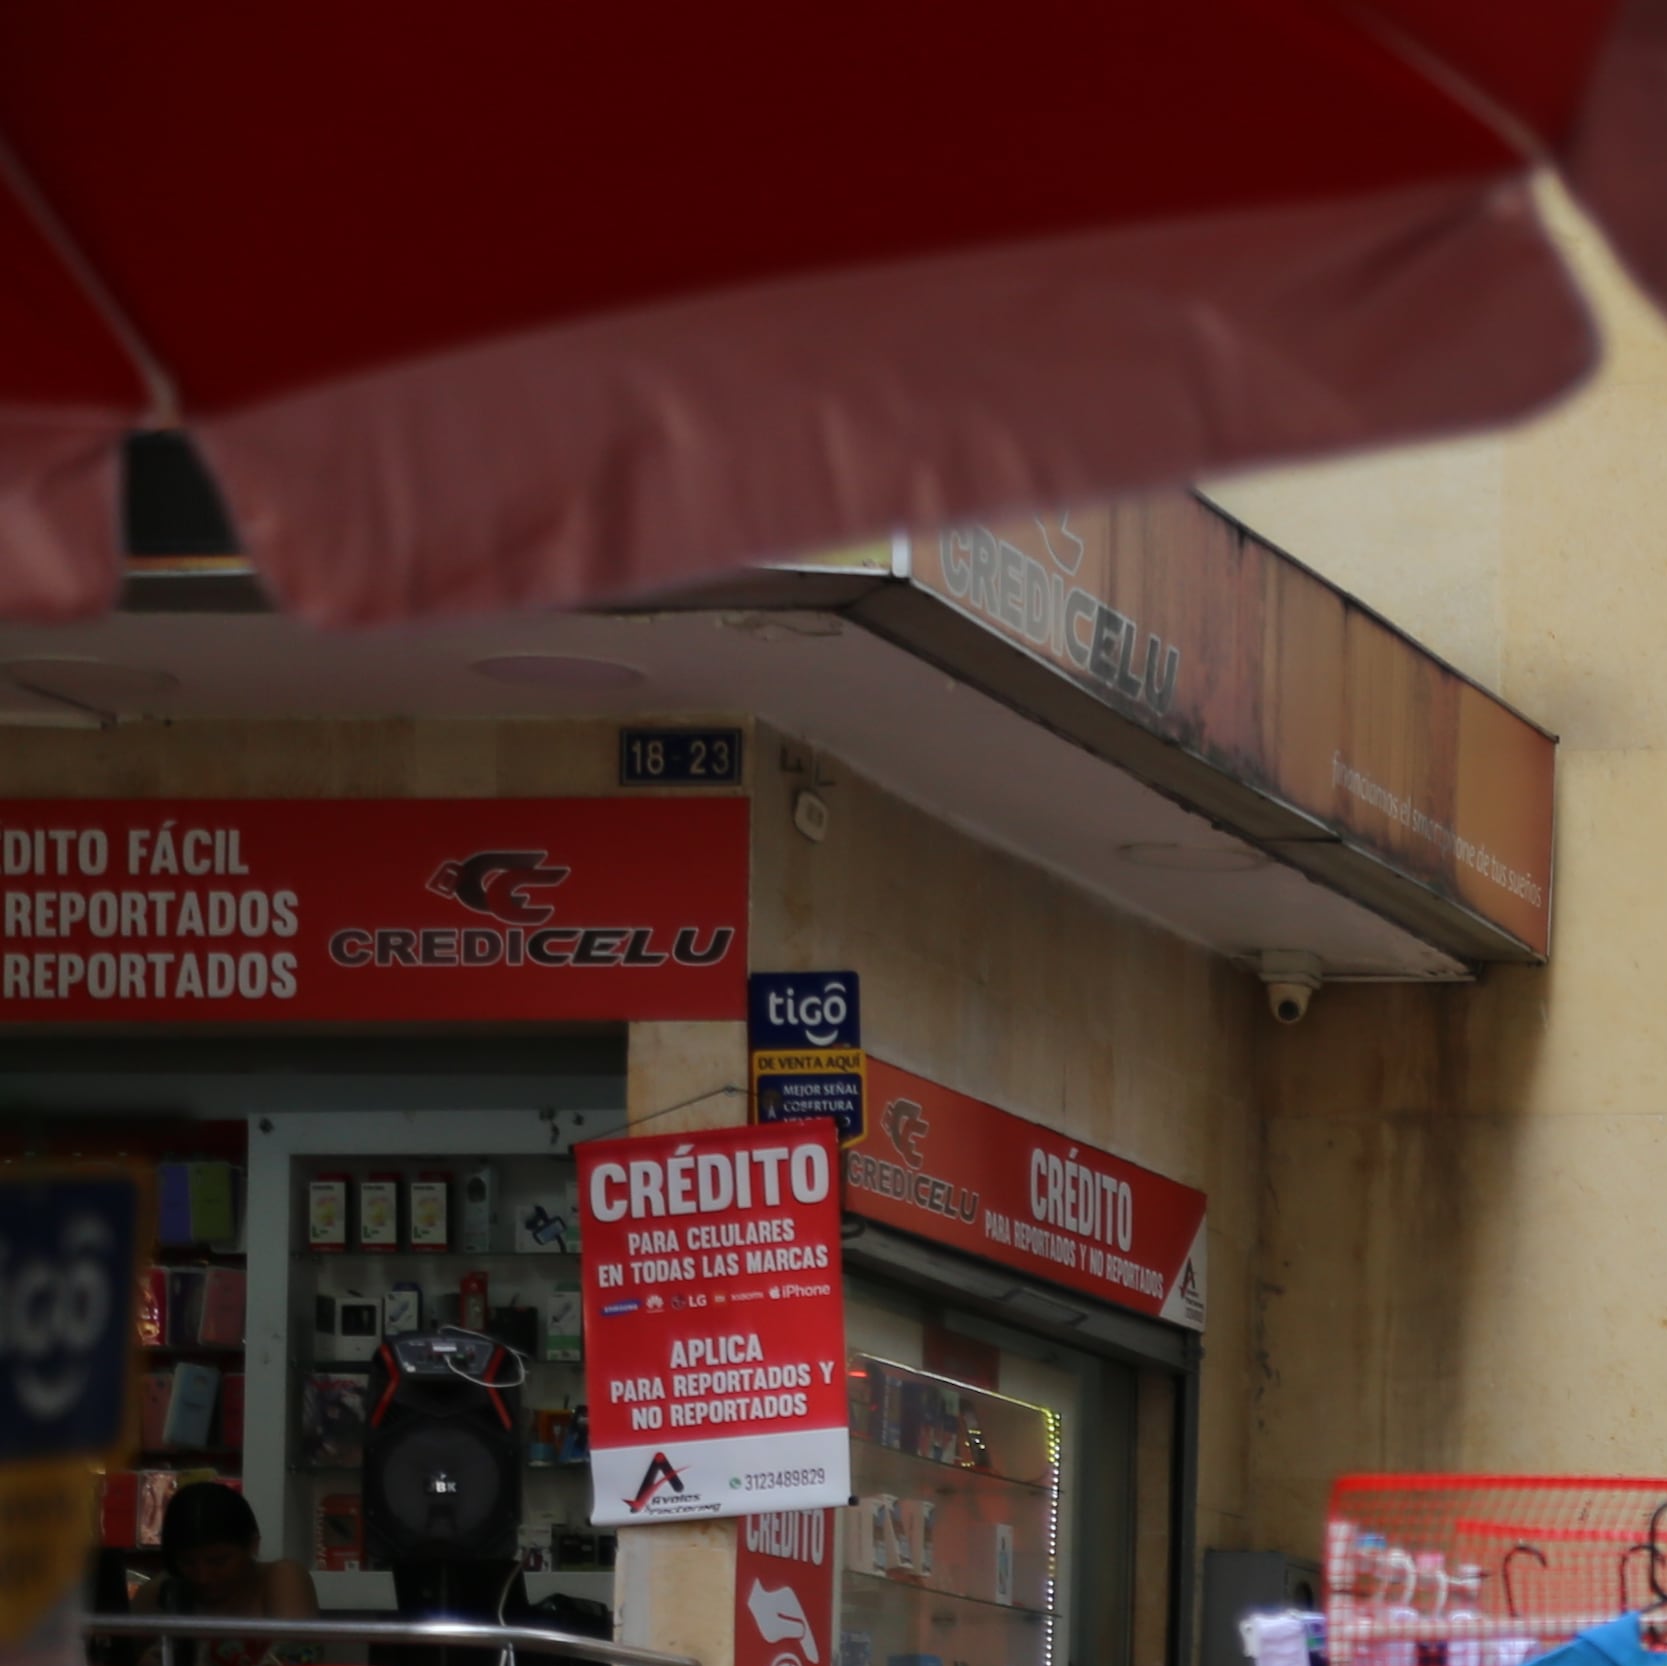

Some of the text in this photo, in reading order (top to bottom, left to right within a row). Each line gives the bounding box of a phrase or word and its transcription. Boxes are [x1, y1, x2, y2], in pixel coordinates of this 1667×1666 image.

[940, 520, 1179, 717] CREDICELU
[127, 820, 249, 876] FÁCIL
[4, 890, 299, 938] REPORTADOS
[328, 927, 735, 967] CREDICELU
[3, 951, 298, 998] REPORTADOS
[758, 1057, 772, 1070] DE
[778, 1055, 824, 1069] VENTA
[783, 1081, 859, 1097] MEJOR SEÑAL
[783, 1099, 855, 1112] COBERTURA
[590, 1144, 830, 1222] CRÉDITO
[848, 1151, 980, 1225] CREDICELU
[1029, 1147, 1134, 1253] CRÉDITO
[628, 1219, 795, 1256] PARA CELULARES
[985, 1209, 1164, 1300] PARA REPORTADOS Y NO REPORTADOS
[598, 1245, 829, 1288] EN TODAS LAS MARCAS
[688, 1294, 707, 1308] LG
[782, 1283, 831, 1299] iPhone
[670, 1334, 764, 1369] APLICA
[610, 1361, 835, 1404] PARA REPORTADOS Y
[632, 1393, 808, 1431] NO REPORTADOS
[743, 1468, 826, 1492] 3123489829
